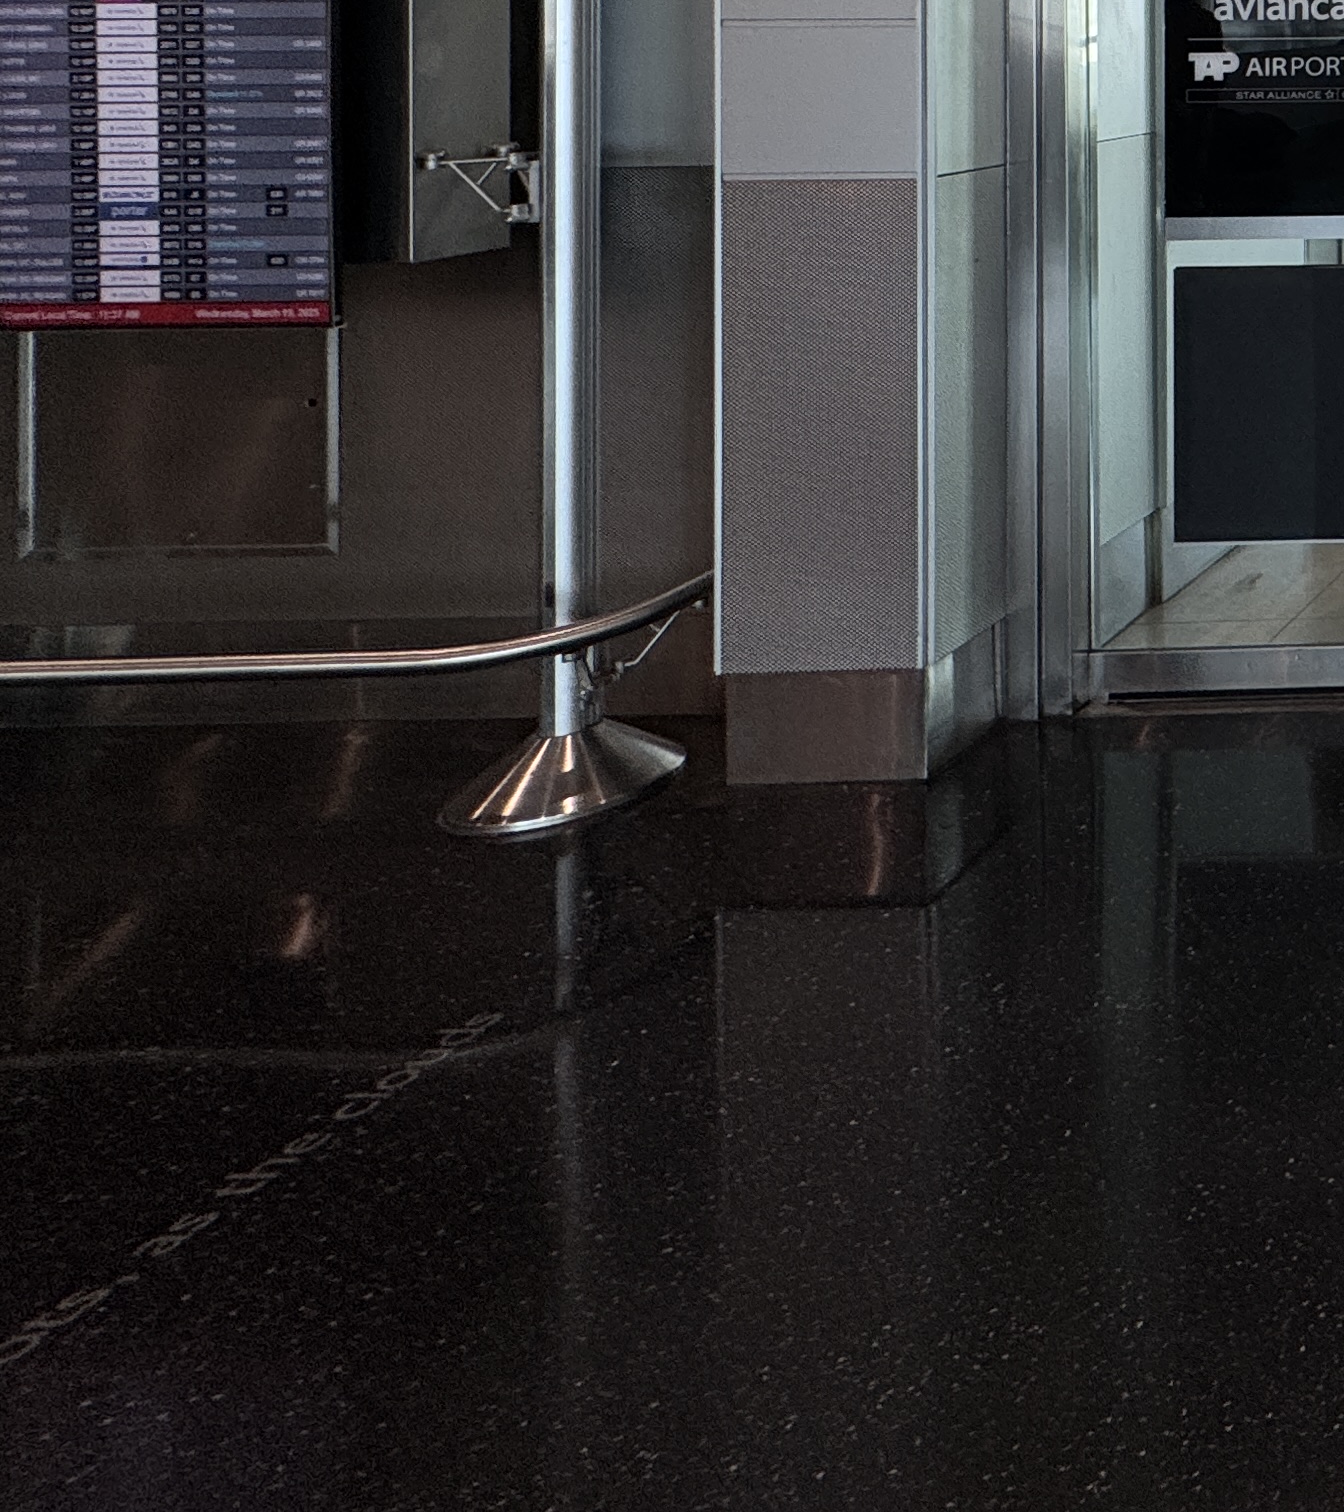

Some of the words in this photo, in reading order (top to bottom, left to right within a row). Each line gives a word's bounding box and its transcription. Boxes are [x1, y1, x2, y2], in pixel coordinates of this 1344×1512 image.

[1188, 52, 1240, 82] TAP
[1236, 90, 1264, 100] STAR
[1267, 90, 1322, 100] ALLIANCE
[215, 1131, 333, 1198] the
[334, 1012, 502, 1121] clouds
